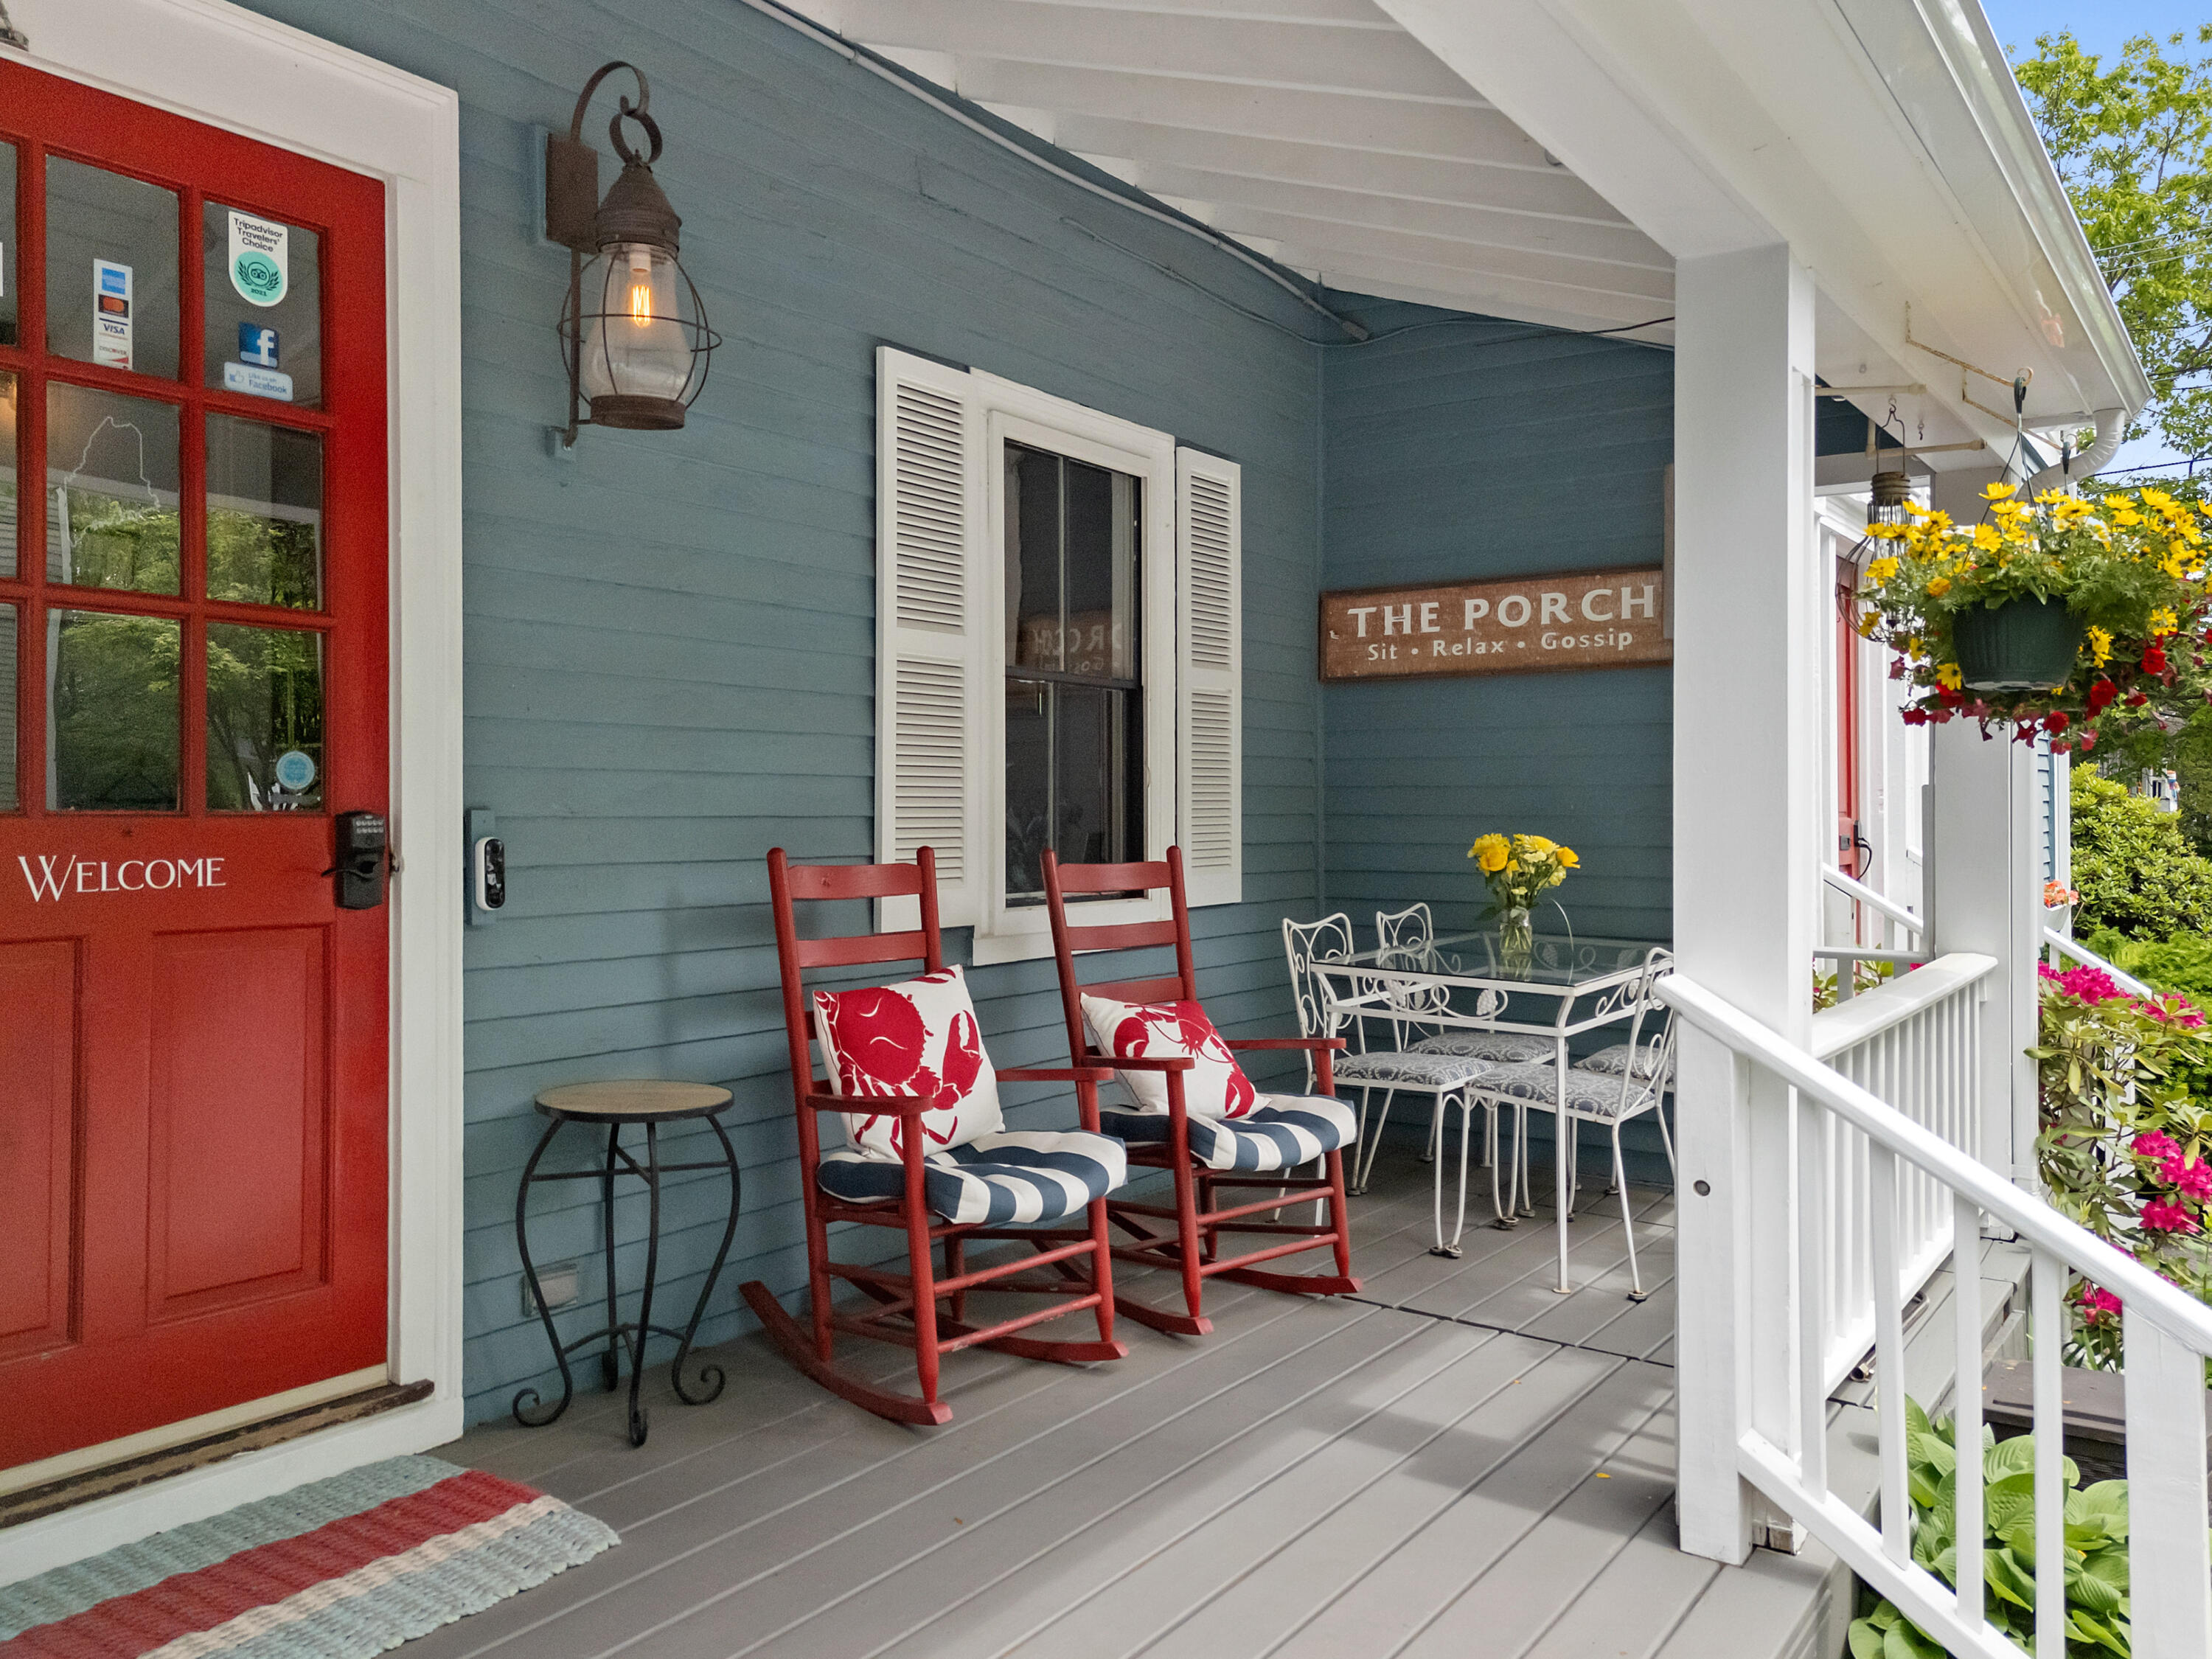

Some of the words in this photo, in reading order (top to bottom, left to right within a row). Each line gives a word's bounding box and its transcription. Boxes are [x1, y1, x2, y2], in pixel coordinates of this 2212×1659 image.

[234, 218, 283, 237] Tripadvisor
[237, 227, 280, 245] Travelers'
[242, 237, 274, 252] Choice
[251, 288, 268, 296] 2021
[102, 324, 125, 335] VISA
[248, 379, 288, 394] Facebook
[1346, 602, 1441, 638] THE
[1464, 585, 1655, 630] PORCH
[1368, 643, 1398, 661] Sit
[1433, 637, 1504, 657] Relax
[1540, 627, 1633, 651] Gossip
[18, 854, 227, 902] WELCOME
